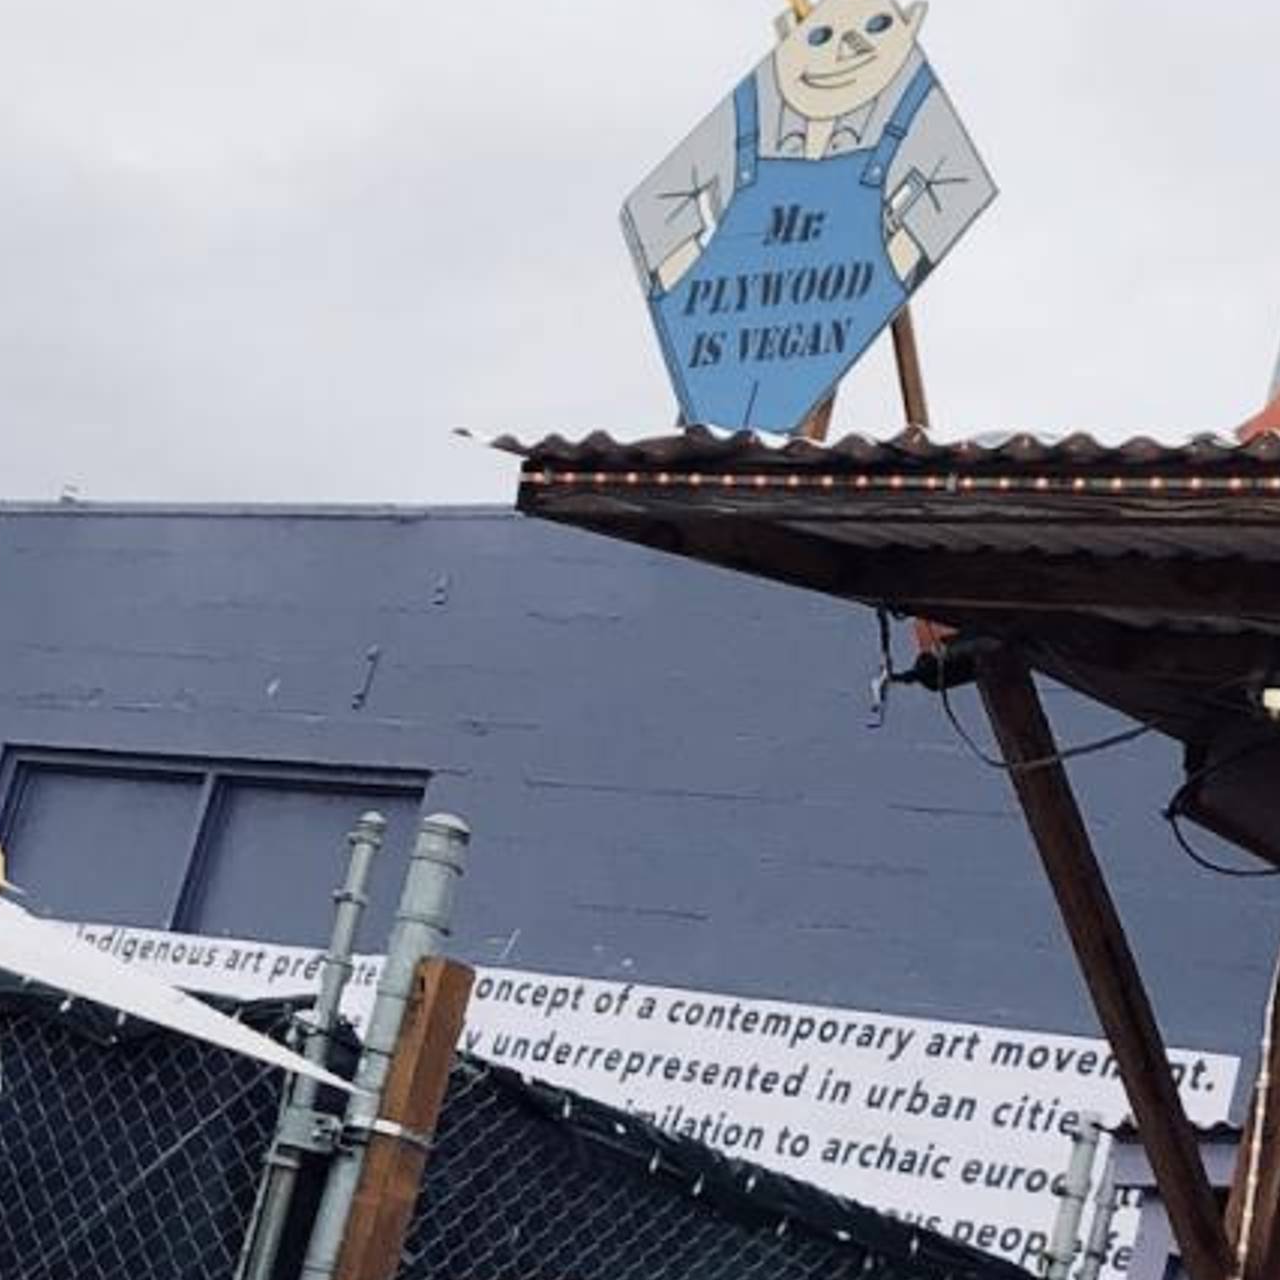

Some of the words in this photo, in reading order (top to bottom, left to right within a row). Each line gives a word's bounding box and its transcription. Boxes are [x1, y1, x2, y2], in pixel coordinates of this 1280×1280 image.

[683, 261, 875, 316] PLYWOOD
[688, 328, 727, 368] IS
[738, 318, 852, 363] VEGAN
[223, 938, 264, 974] art
[475, 977, 585, 1017] oncept
[594, 984, 637, 1015] of
[637, 996, 657, 1020] a
[667, 999, 916, 1062] contemporary
[925, 1031, 981, 1060] art
[492, 1030, 810, 1097] underrepresented
[817, 1068, 852, 1104] in
[867, 1079, 977, 1121] urban
[992, 1095, 1081, 1137] citie
[776, 1125, 810, 1159] to
[821, 1132, 951, 1178] archaic
